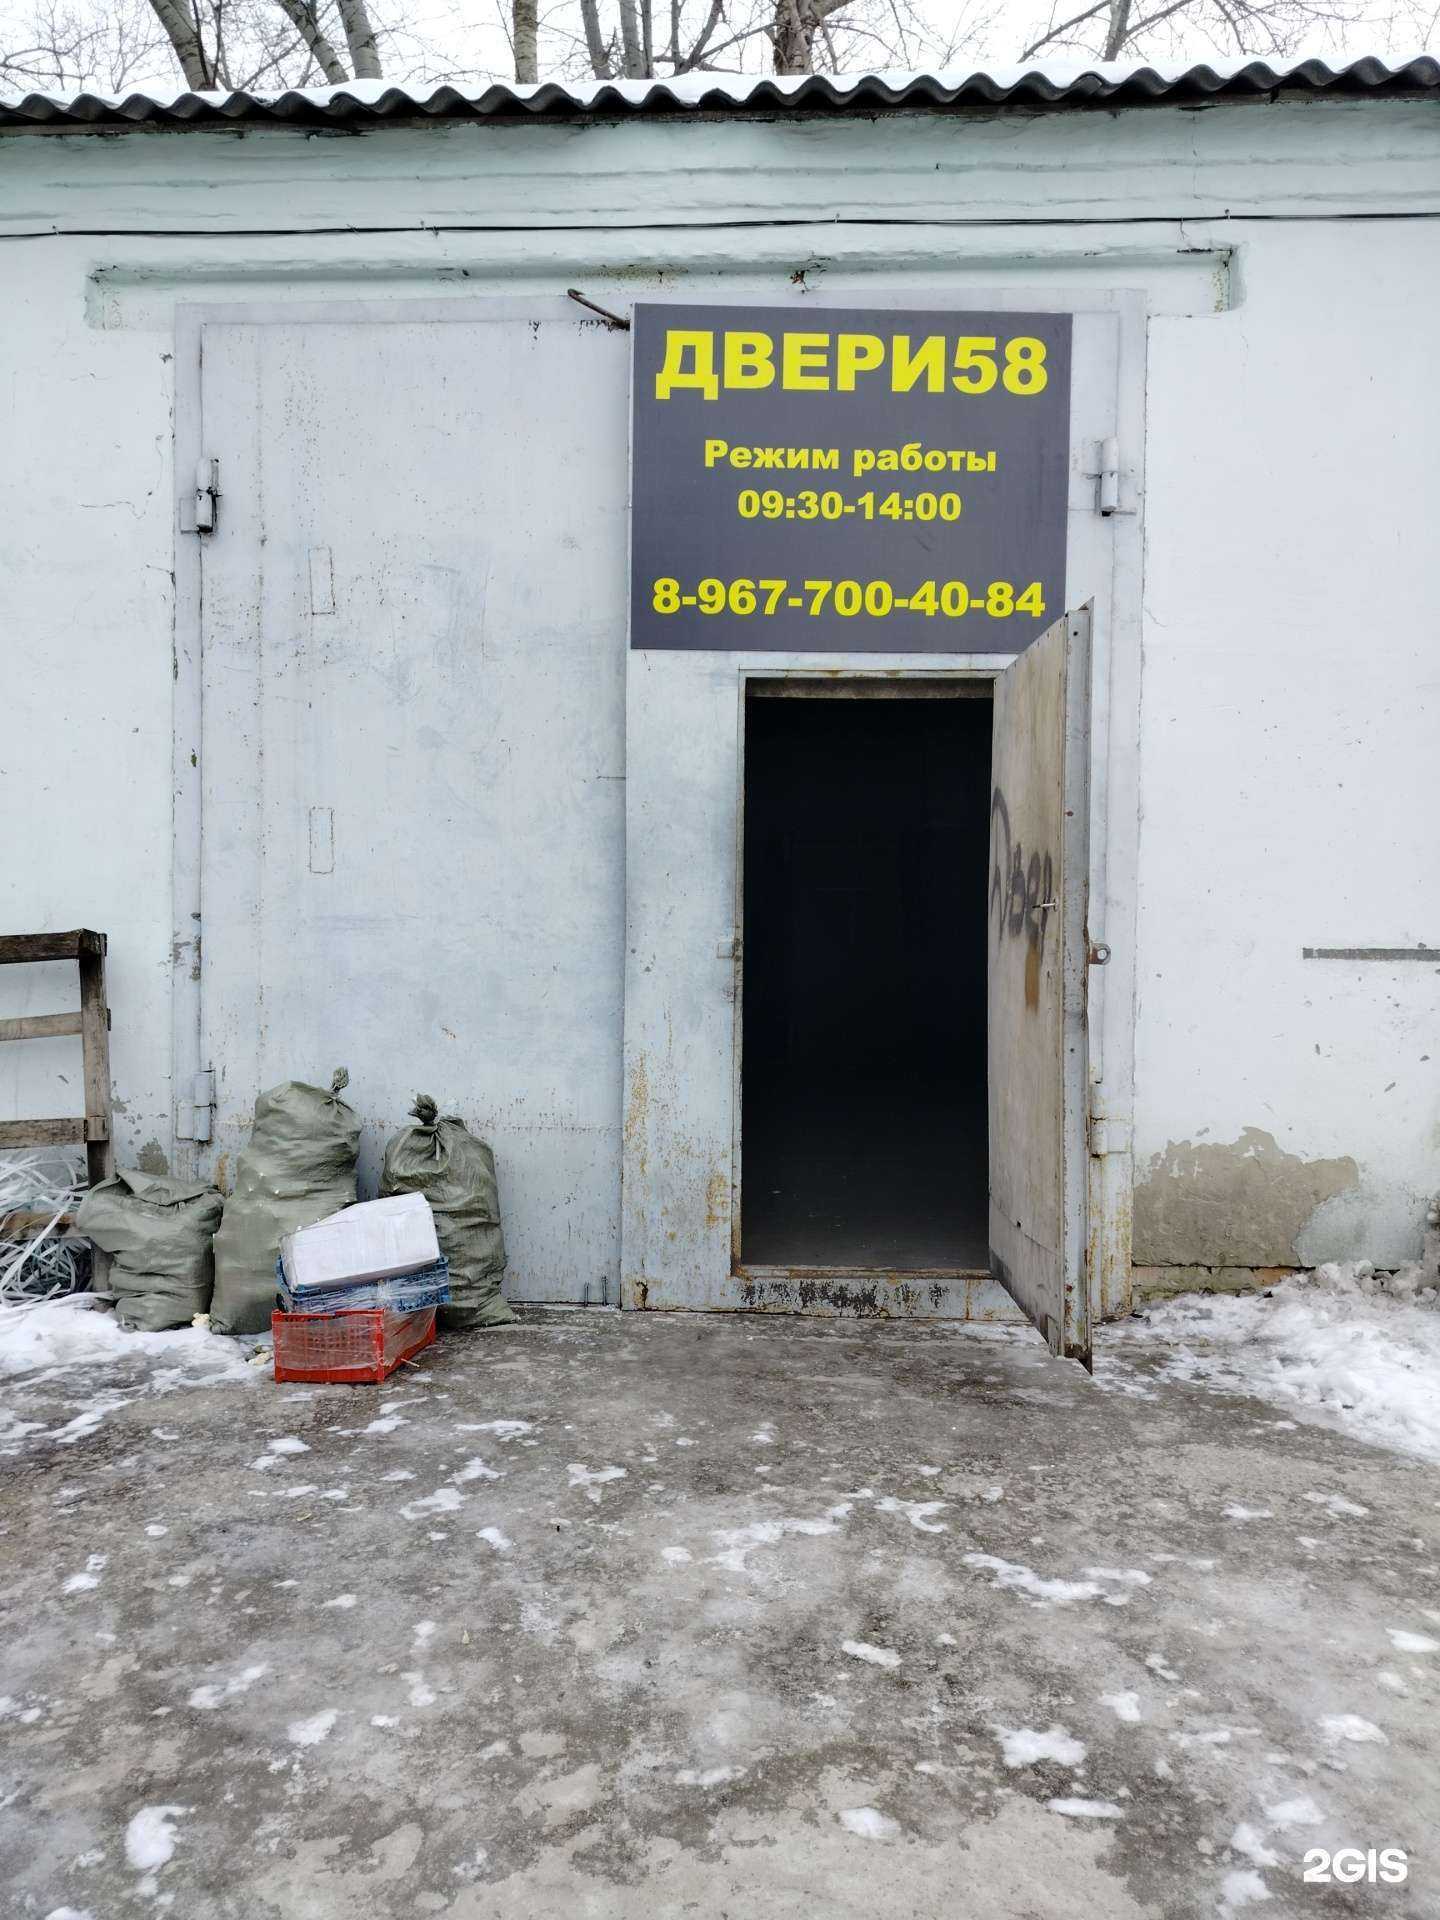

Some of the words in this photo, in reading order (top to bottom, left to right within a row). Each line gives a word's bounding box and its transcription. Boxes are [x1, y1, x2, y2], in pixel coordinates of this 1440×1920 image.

[655, 329, 1049, 401] ДВЕРИ58
[704, 439, 840, 470] Режим
[852, 442, 997, 477] работы
[737, 489, 962, 521] 09:30-14:00
[652, 577, 1046, 618] 8-967-700-40-84
